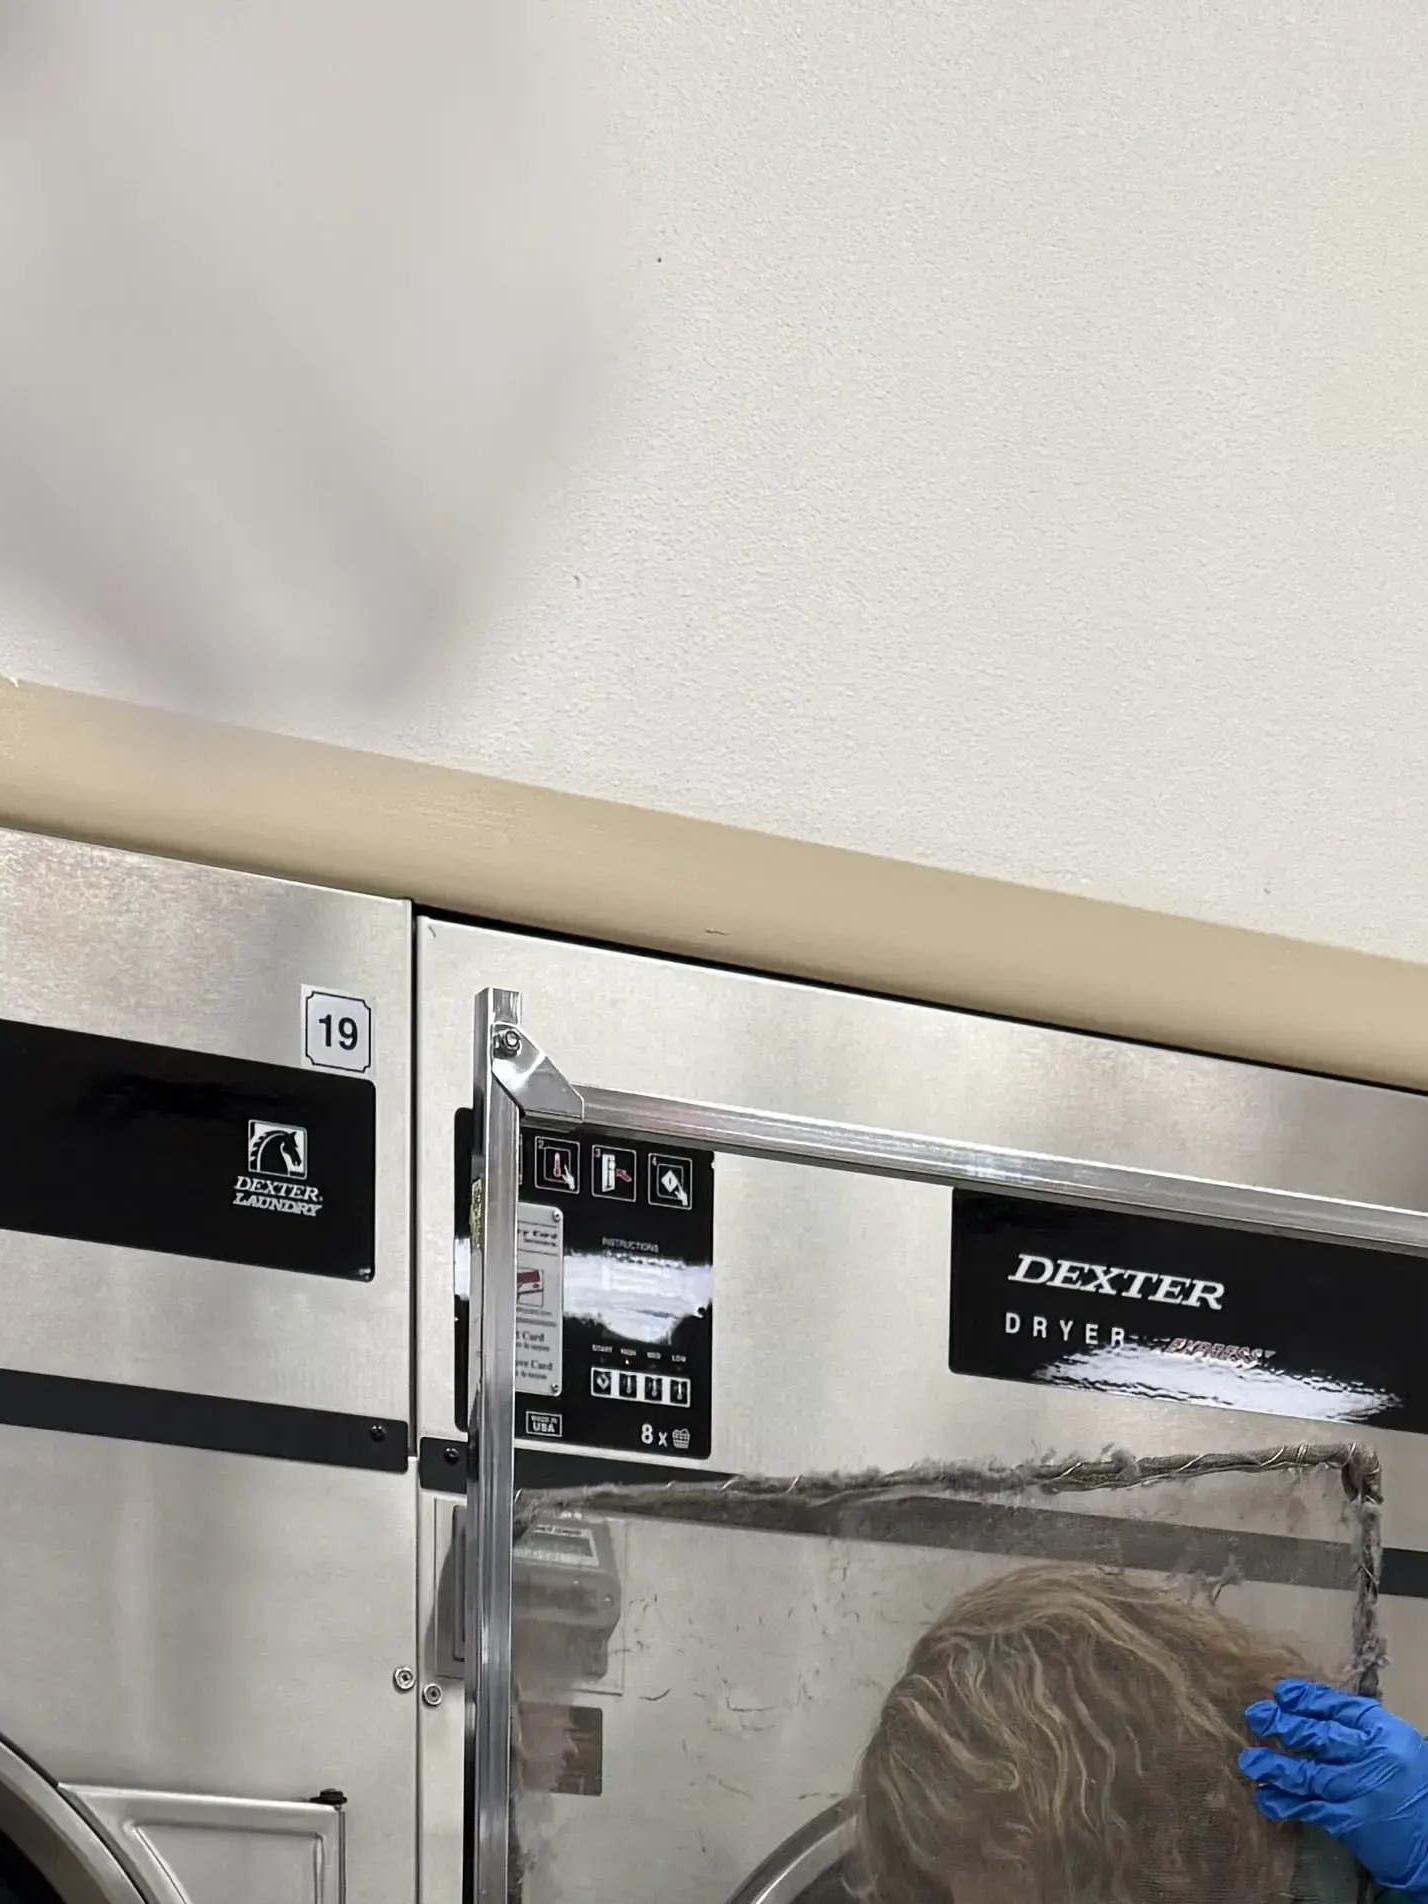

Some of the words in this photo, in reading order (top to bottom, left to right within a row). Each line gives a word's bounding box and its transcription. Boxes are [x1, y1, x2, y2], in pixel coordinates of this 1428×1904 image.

[318, 1012, 360, 1053] 19
[232, 1192, 323, 1217] LAUNDRY
[1007, 1253, 1225, 1310] DEXTER
[1005, 1312, 1125, 1347] DRYER
[532, 1422, 555, 1434] USA
[641, 1423, 653, 1444] 8
